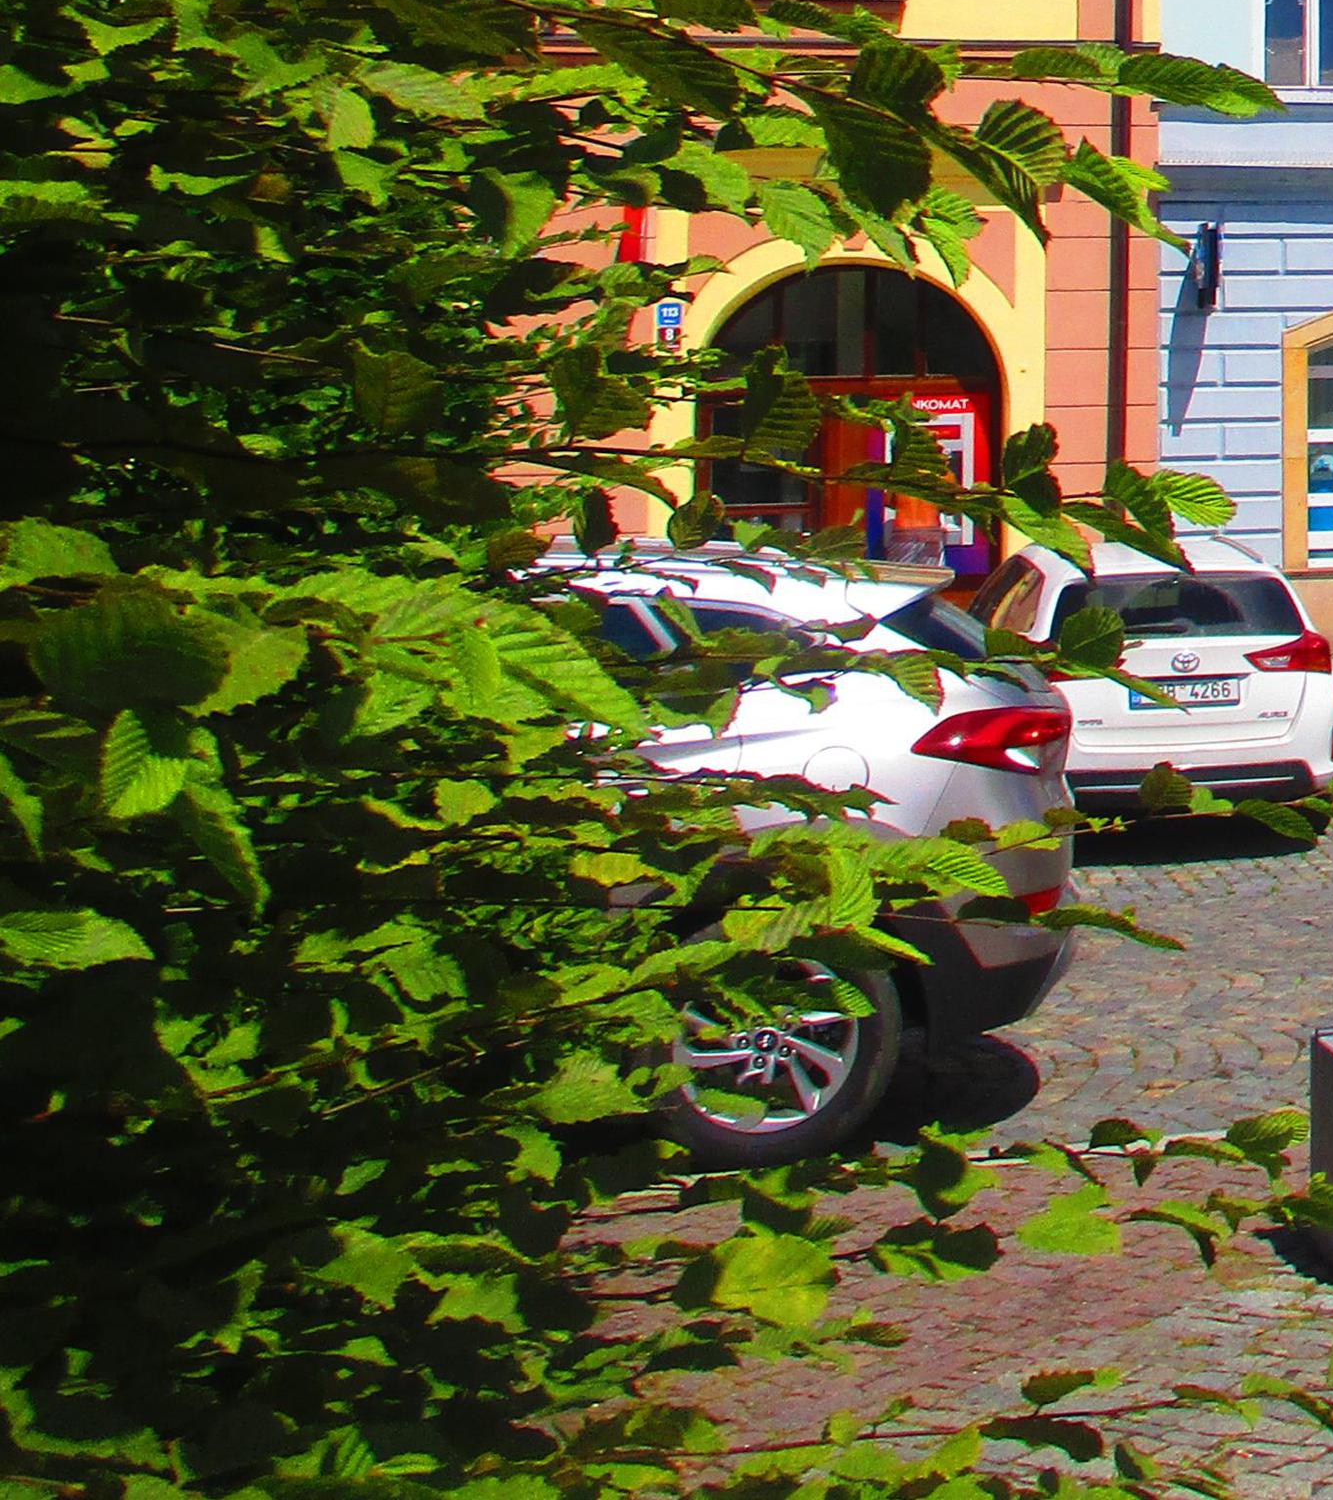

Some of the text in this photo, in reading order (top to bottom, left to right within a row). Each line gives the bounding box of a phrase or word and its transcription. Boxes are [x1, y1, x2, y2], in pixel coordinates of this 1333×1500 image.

[661, 307, 679, 317] 113
[665, 328, 674, 341] 8
[911, 398, 969, 410] NKOMAT
[1189, 681, 1231, 700] 4266
